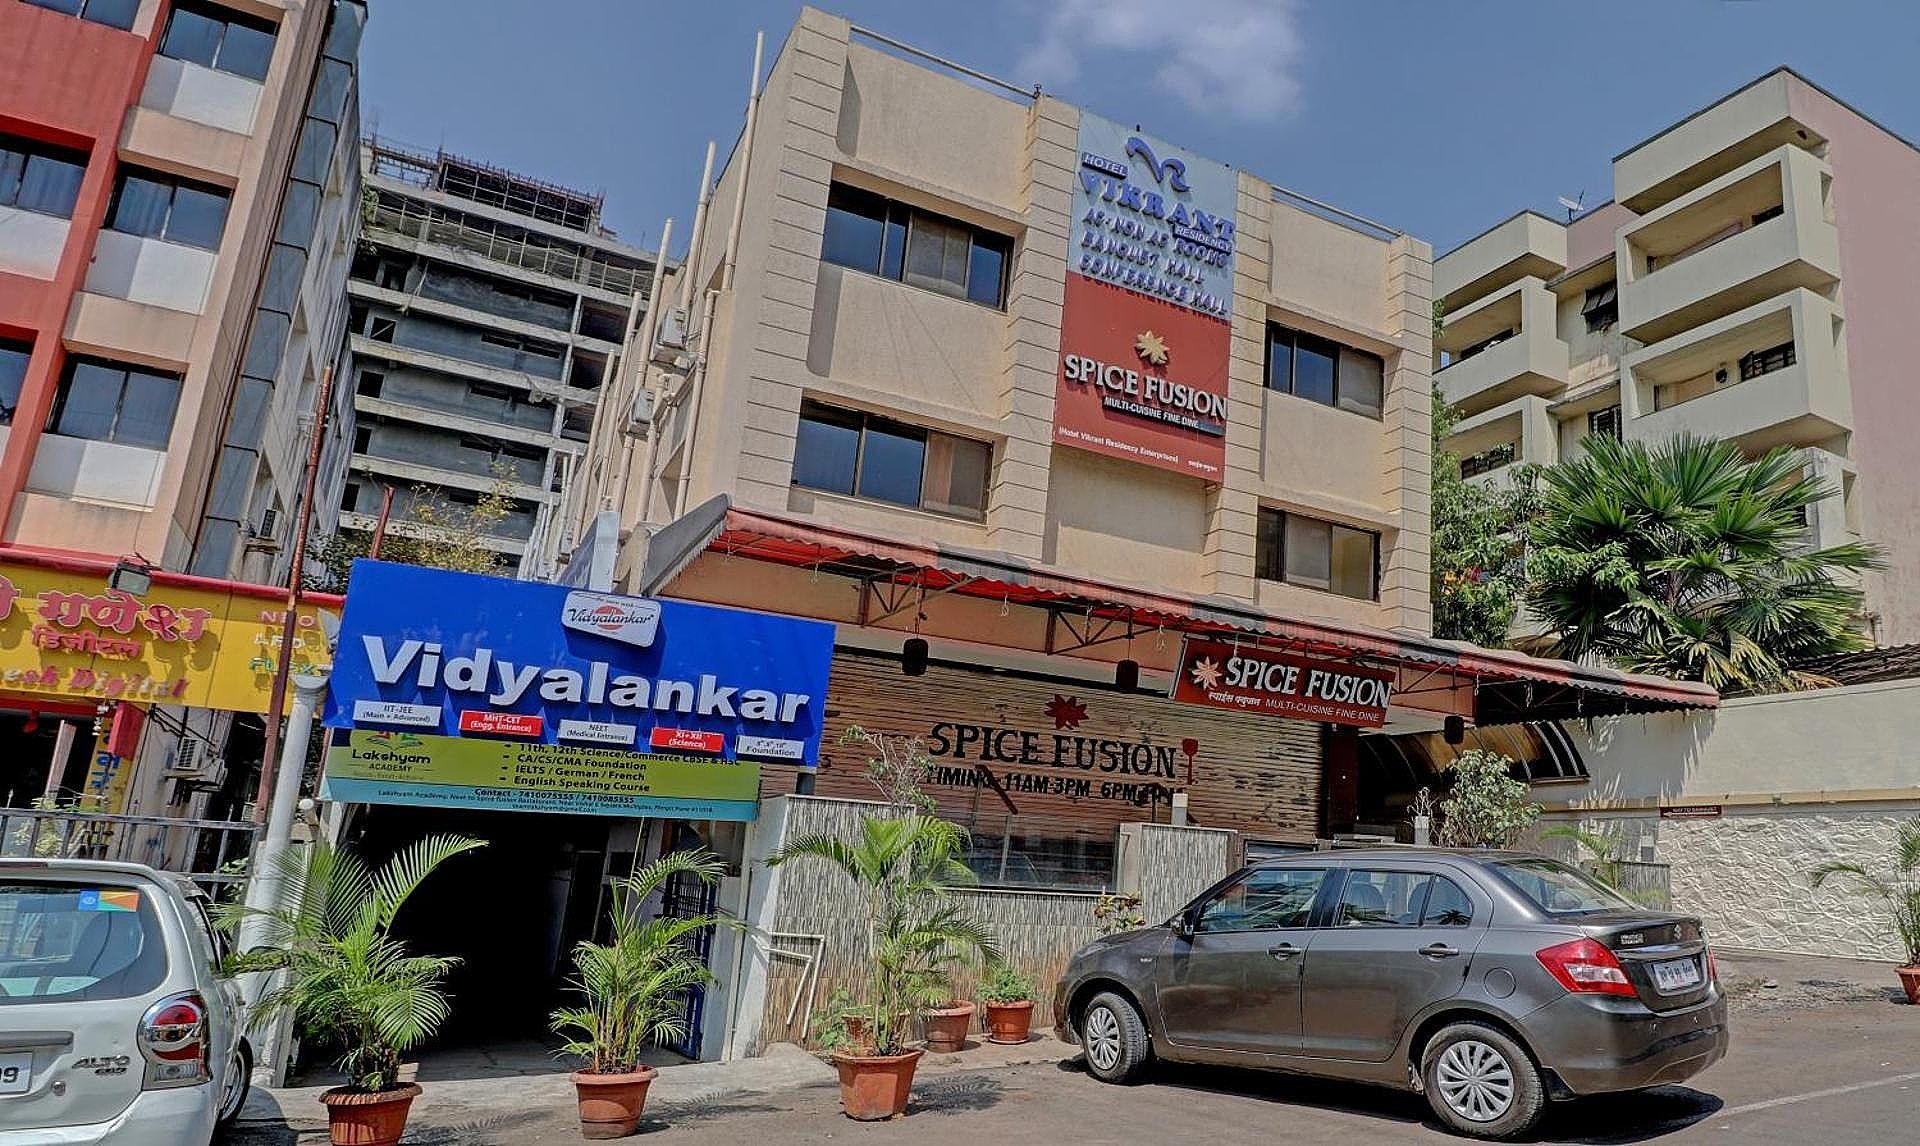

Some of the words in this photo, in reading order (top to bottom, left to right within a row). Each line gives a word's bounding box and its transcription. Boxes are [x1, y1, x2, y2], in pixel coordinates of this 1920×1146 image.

[1084, 153, 1127, 174] HOTEL
[1079, 169, 1236, 241] VIKRANT
[1176, 226, 1232, 251] RESIDENCY
[1081, 229, 1160, 267] BANQUET
[1165, 258, 1205, 284] HALL
[1174, 238, 1229, 268] ROOMS
[1080, 253, 1188, 300] CONFERENCE
[1190, 289, 1228, 315] HALL
[1064, 354, 1139, 395] SPICE
[1144, 375, 1228, 419] FUSION
[1103, 396, 1162, 419] MULTI-CUISINE
[1163, 411, 1181, 424] FINE
[1181, 416, 1199, 428] DINE
[568, 607, 654, 626] Vidyalankar
[362, 635, 810, 722] Vidyalankar
[1225, 656, 1301, 695] SPICE
[1305, 668, 1392, 708] FUSION
[383, 704, 414, 715] IIT-JEE
[1265, 699, 1335, 716] MULTI-CUISINE
[1336, 707, 1357, 719] FINE
[1357, 710, 1379, 722] DINE
[393, 713, 431, 723] Advanced)
[484, 713, 521, 724] MHT-CET
[470, 720, 495, 731] (Engg.
[497, 722, 532, 734] Entrance)
[589, 723, 608, 733] NEET
[566, 729, 597, 739] (Medical
[598, 732, 628, 742] Entrance)
[668, 737, 707, 750] (Science)
[351, 749, 431, 765] Lakshyam
[553, 745, 577, 755] 12th
[580, 747, 680, 762] Science/Commerce
[746, 745, 796, 757] Foundation
[929, 721, 1041, 765] SPICE
[1051, 734, 1177, 778] FUSION
[368, 763, 412, 772] ACADEMY
[517, 754, 581, 766] CA/CS/CMA
[585, 759, 647, 770] Foundation
[515, 765, 545, 774] IELTS
[555, 768, 599, 778] German
[608, 771, 645, 781] French
[514, 776, 556, 787] English
[559, 778, 610, 791] Speaking
[613, 782, 650, 792] Course
[474, 788, 510, 798] Contact
[71, 1055, 131, 1070] ALTO
